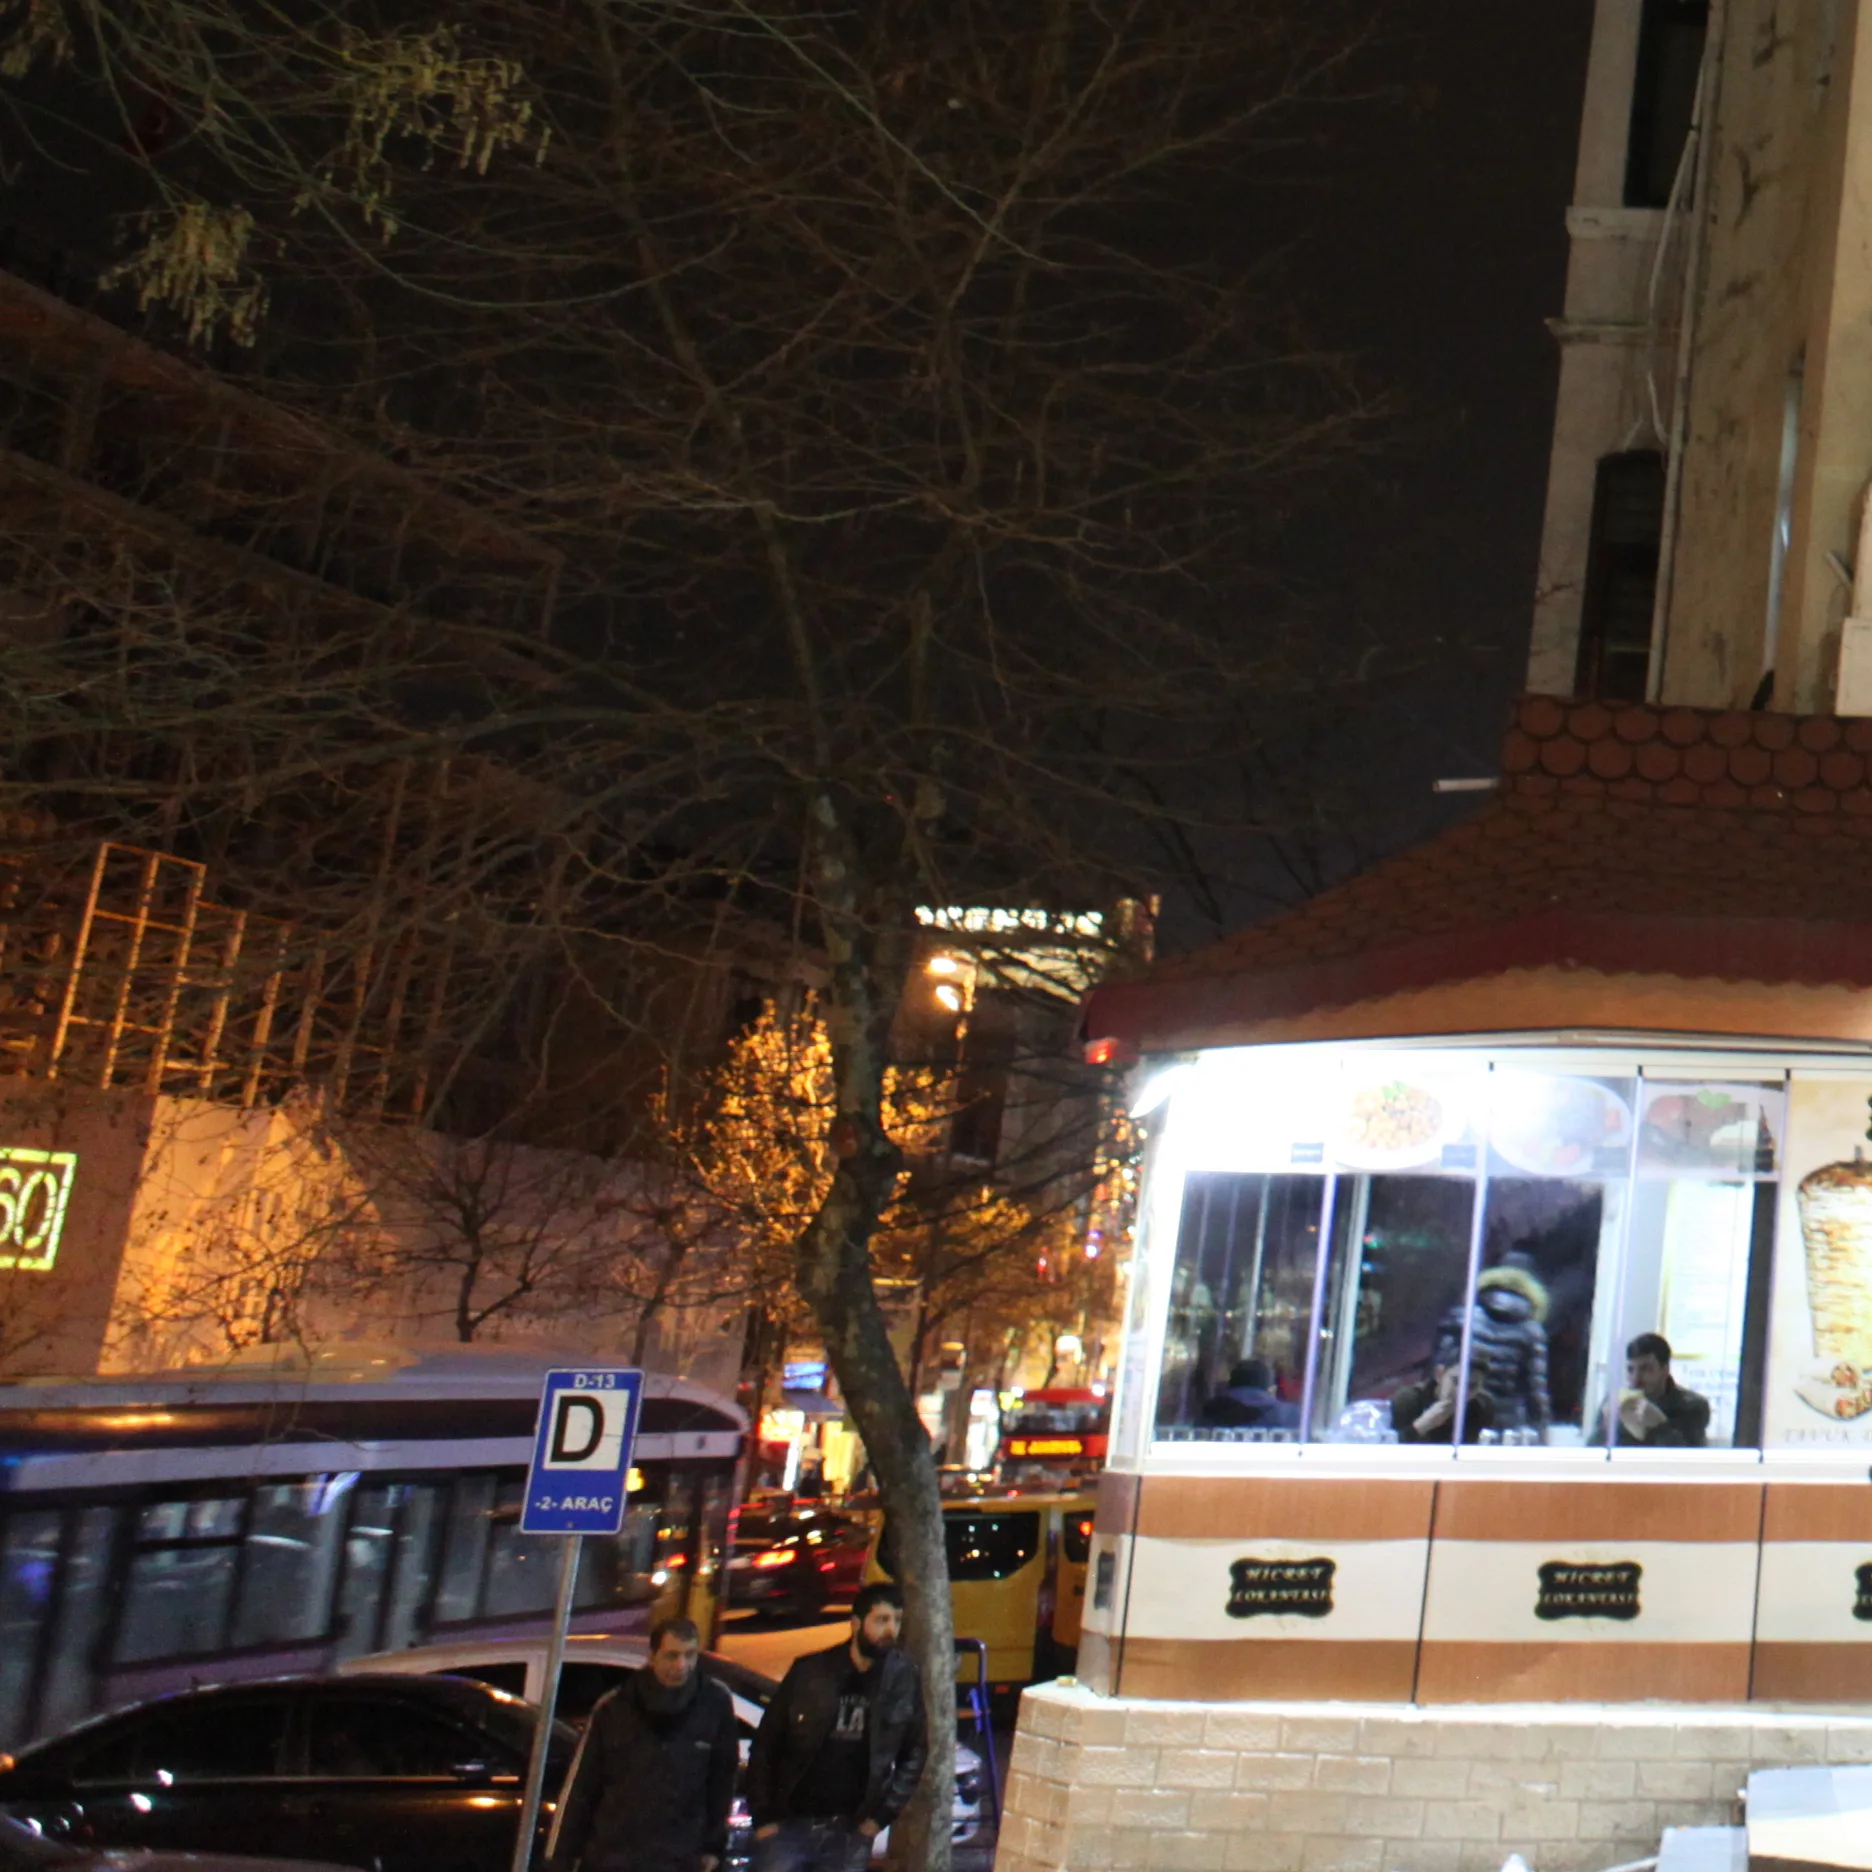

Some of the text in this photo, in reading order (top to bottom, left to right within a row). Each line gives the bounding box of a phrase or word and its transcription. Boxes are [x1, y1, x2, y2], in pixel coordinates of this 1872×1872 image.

[574, 1374, 616, 1389] D-13
[550, 1395, 605, 1463] D
[560, 1497, 613, 1513] ARAÇ
